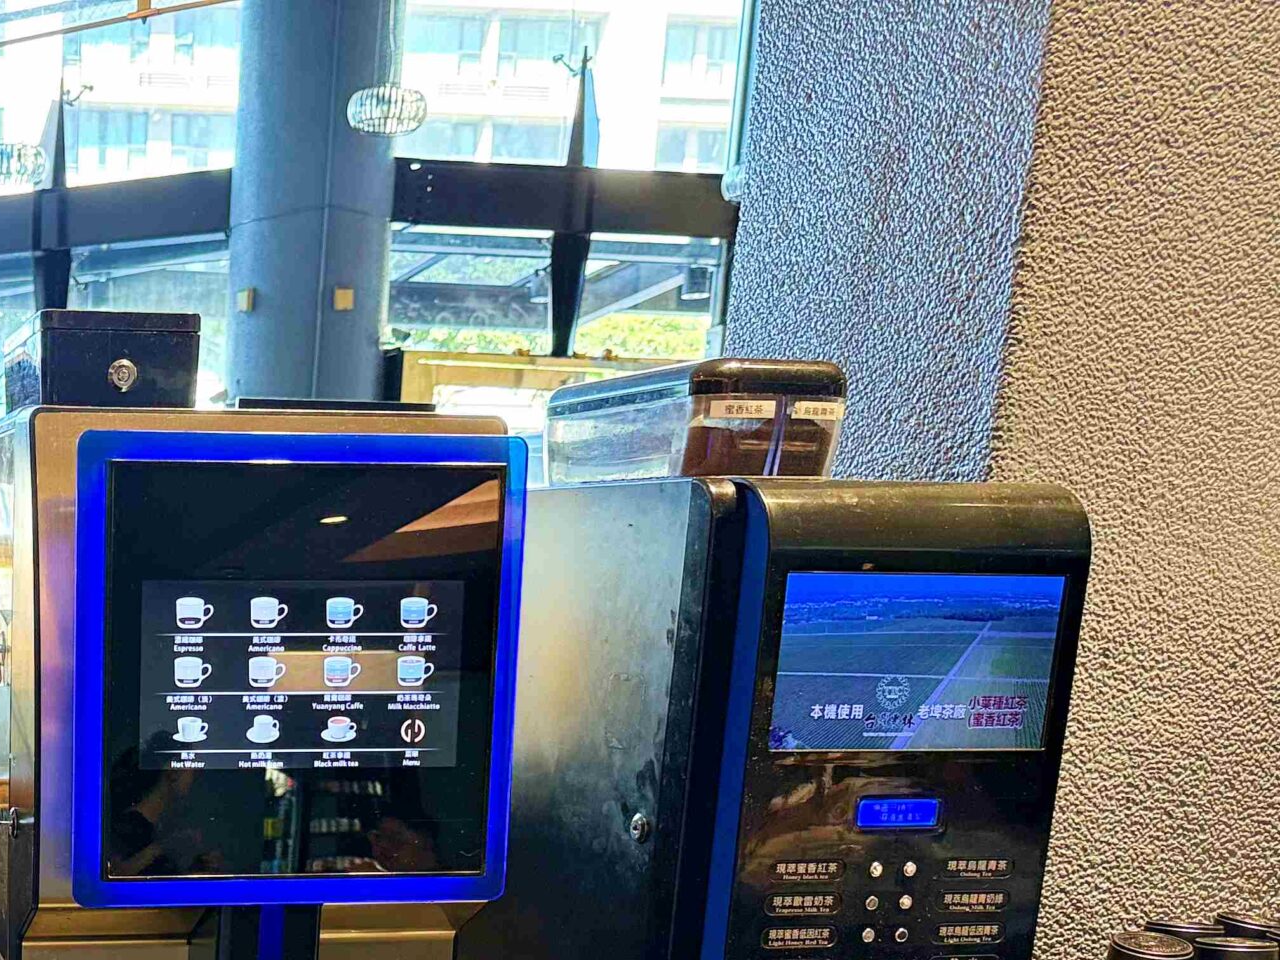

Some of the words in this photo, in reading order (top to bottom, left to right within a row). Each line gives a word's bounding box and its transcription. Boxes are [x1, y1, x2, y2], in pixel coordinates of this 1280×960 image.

[173, 644, 204, 653] Espresso
[248, 644, 285, 652] Americano
[322, 643, 363, 653] Cappuccino
[398, 643, 417, 651] Caffe
[418, 643, 437, 651] Latte
[169, 704, 208, 712] Americano
[245, 703, 283, 711] Americano
[312, 702, 345, 712] Yuanyang
[810, 704, 864, 720] 本機使用
[170, 760, 184, 768] Hot
[185, 760, 206, 768] Water
[238, 760, 252, 768] Hot
[402, 758, 421, 767] Menu
